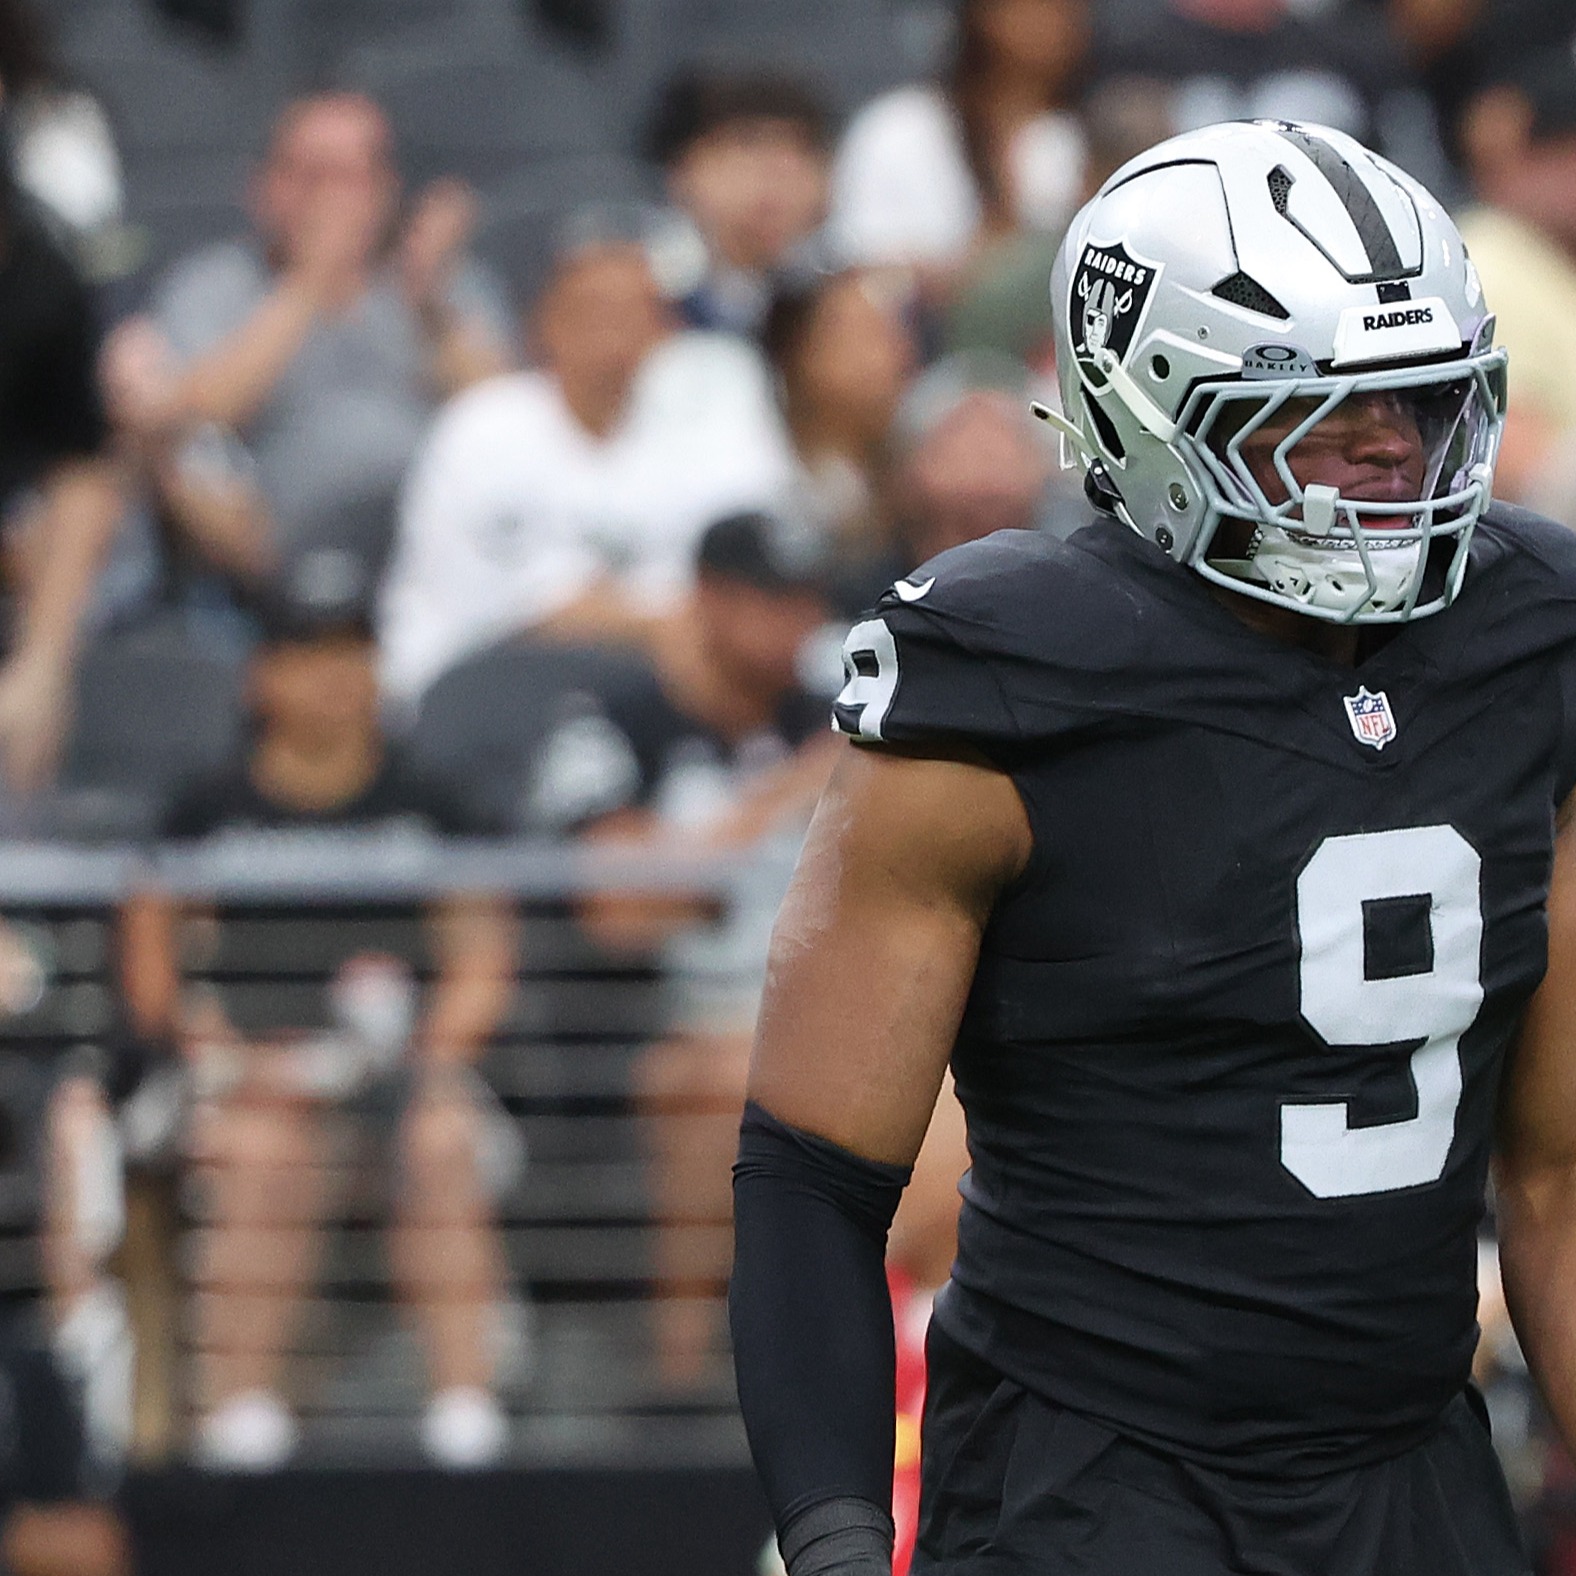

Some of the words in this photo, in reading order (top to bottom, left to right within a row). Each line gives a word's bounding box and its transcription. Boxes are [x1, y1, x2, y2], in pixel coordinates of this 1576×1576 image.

[1084, 248, 1147, 285] RAIDERS
[1363, 307, 1433, 332] RAIDERS
[1244, 360, 1308, 373] OAKLEY
[830, 617, 899, 743] 9
[1359, 714, 1391, 737] NFL
[1281, 824, 1485, 1199] 9
